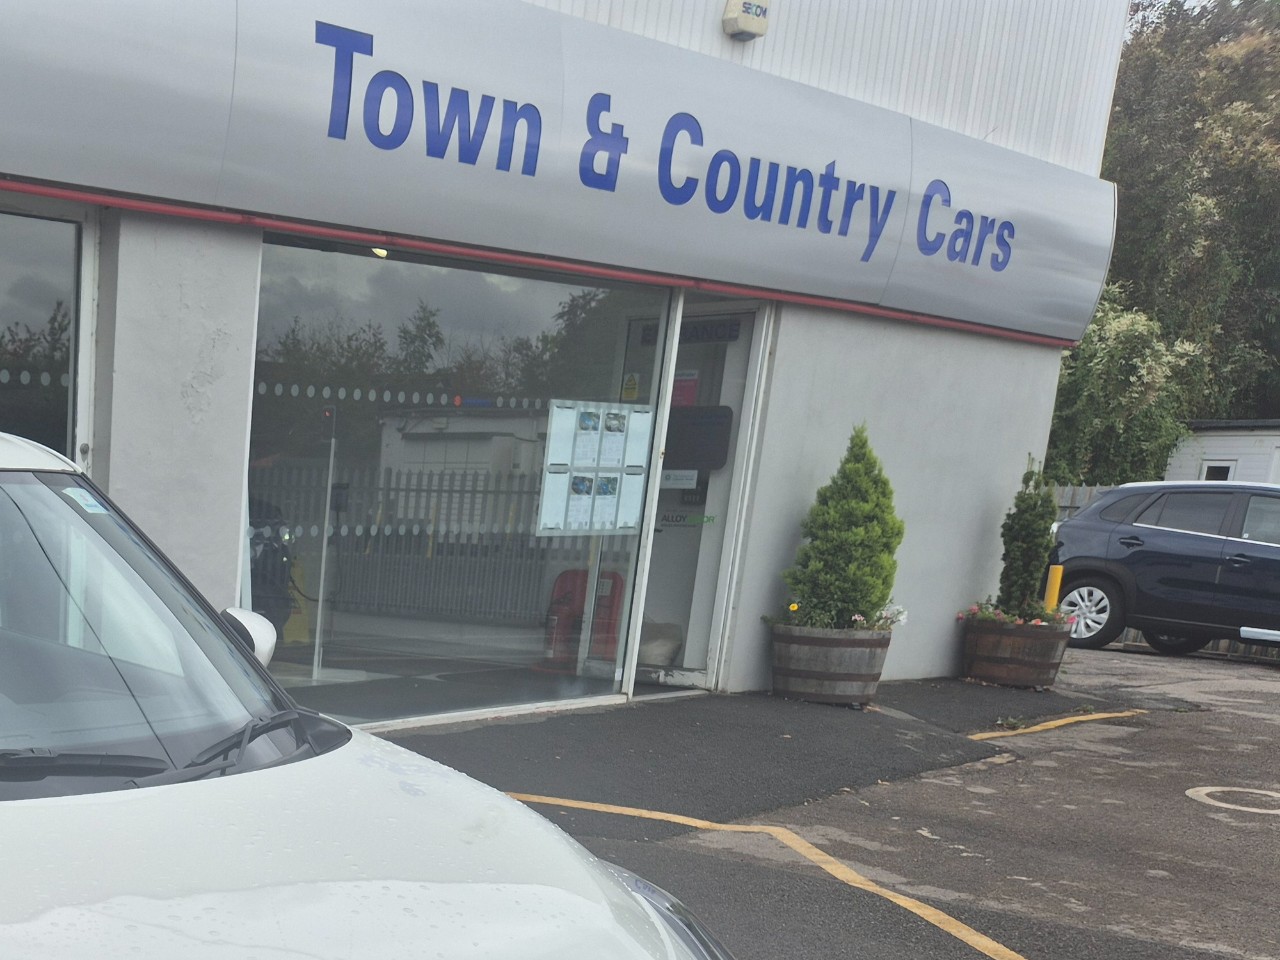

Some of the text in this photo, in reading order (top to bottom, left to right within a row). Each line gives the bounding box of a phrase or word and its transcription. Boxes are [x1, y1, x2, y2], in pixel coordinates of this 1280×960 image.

[742, 2, 768, 18] SECOM
[315, 20, 1015, 272] Town & Country Cars
